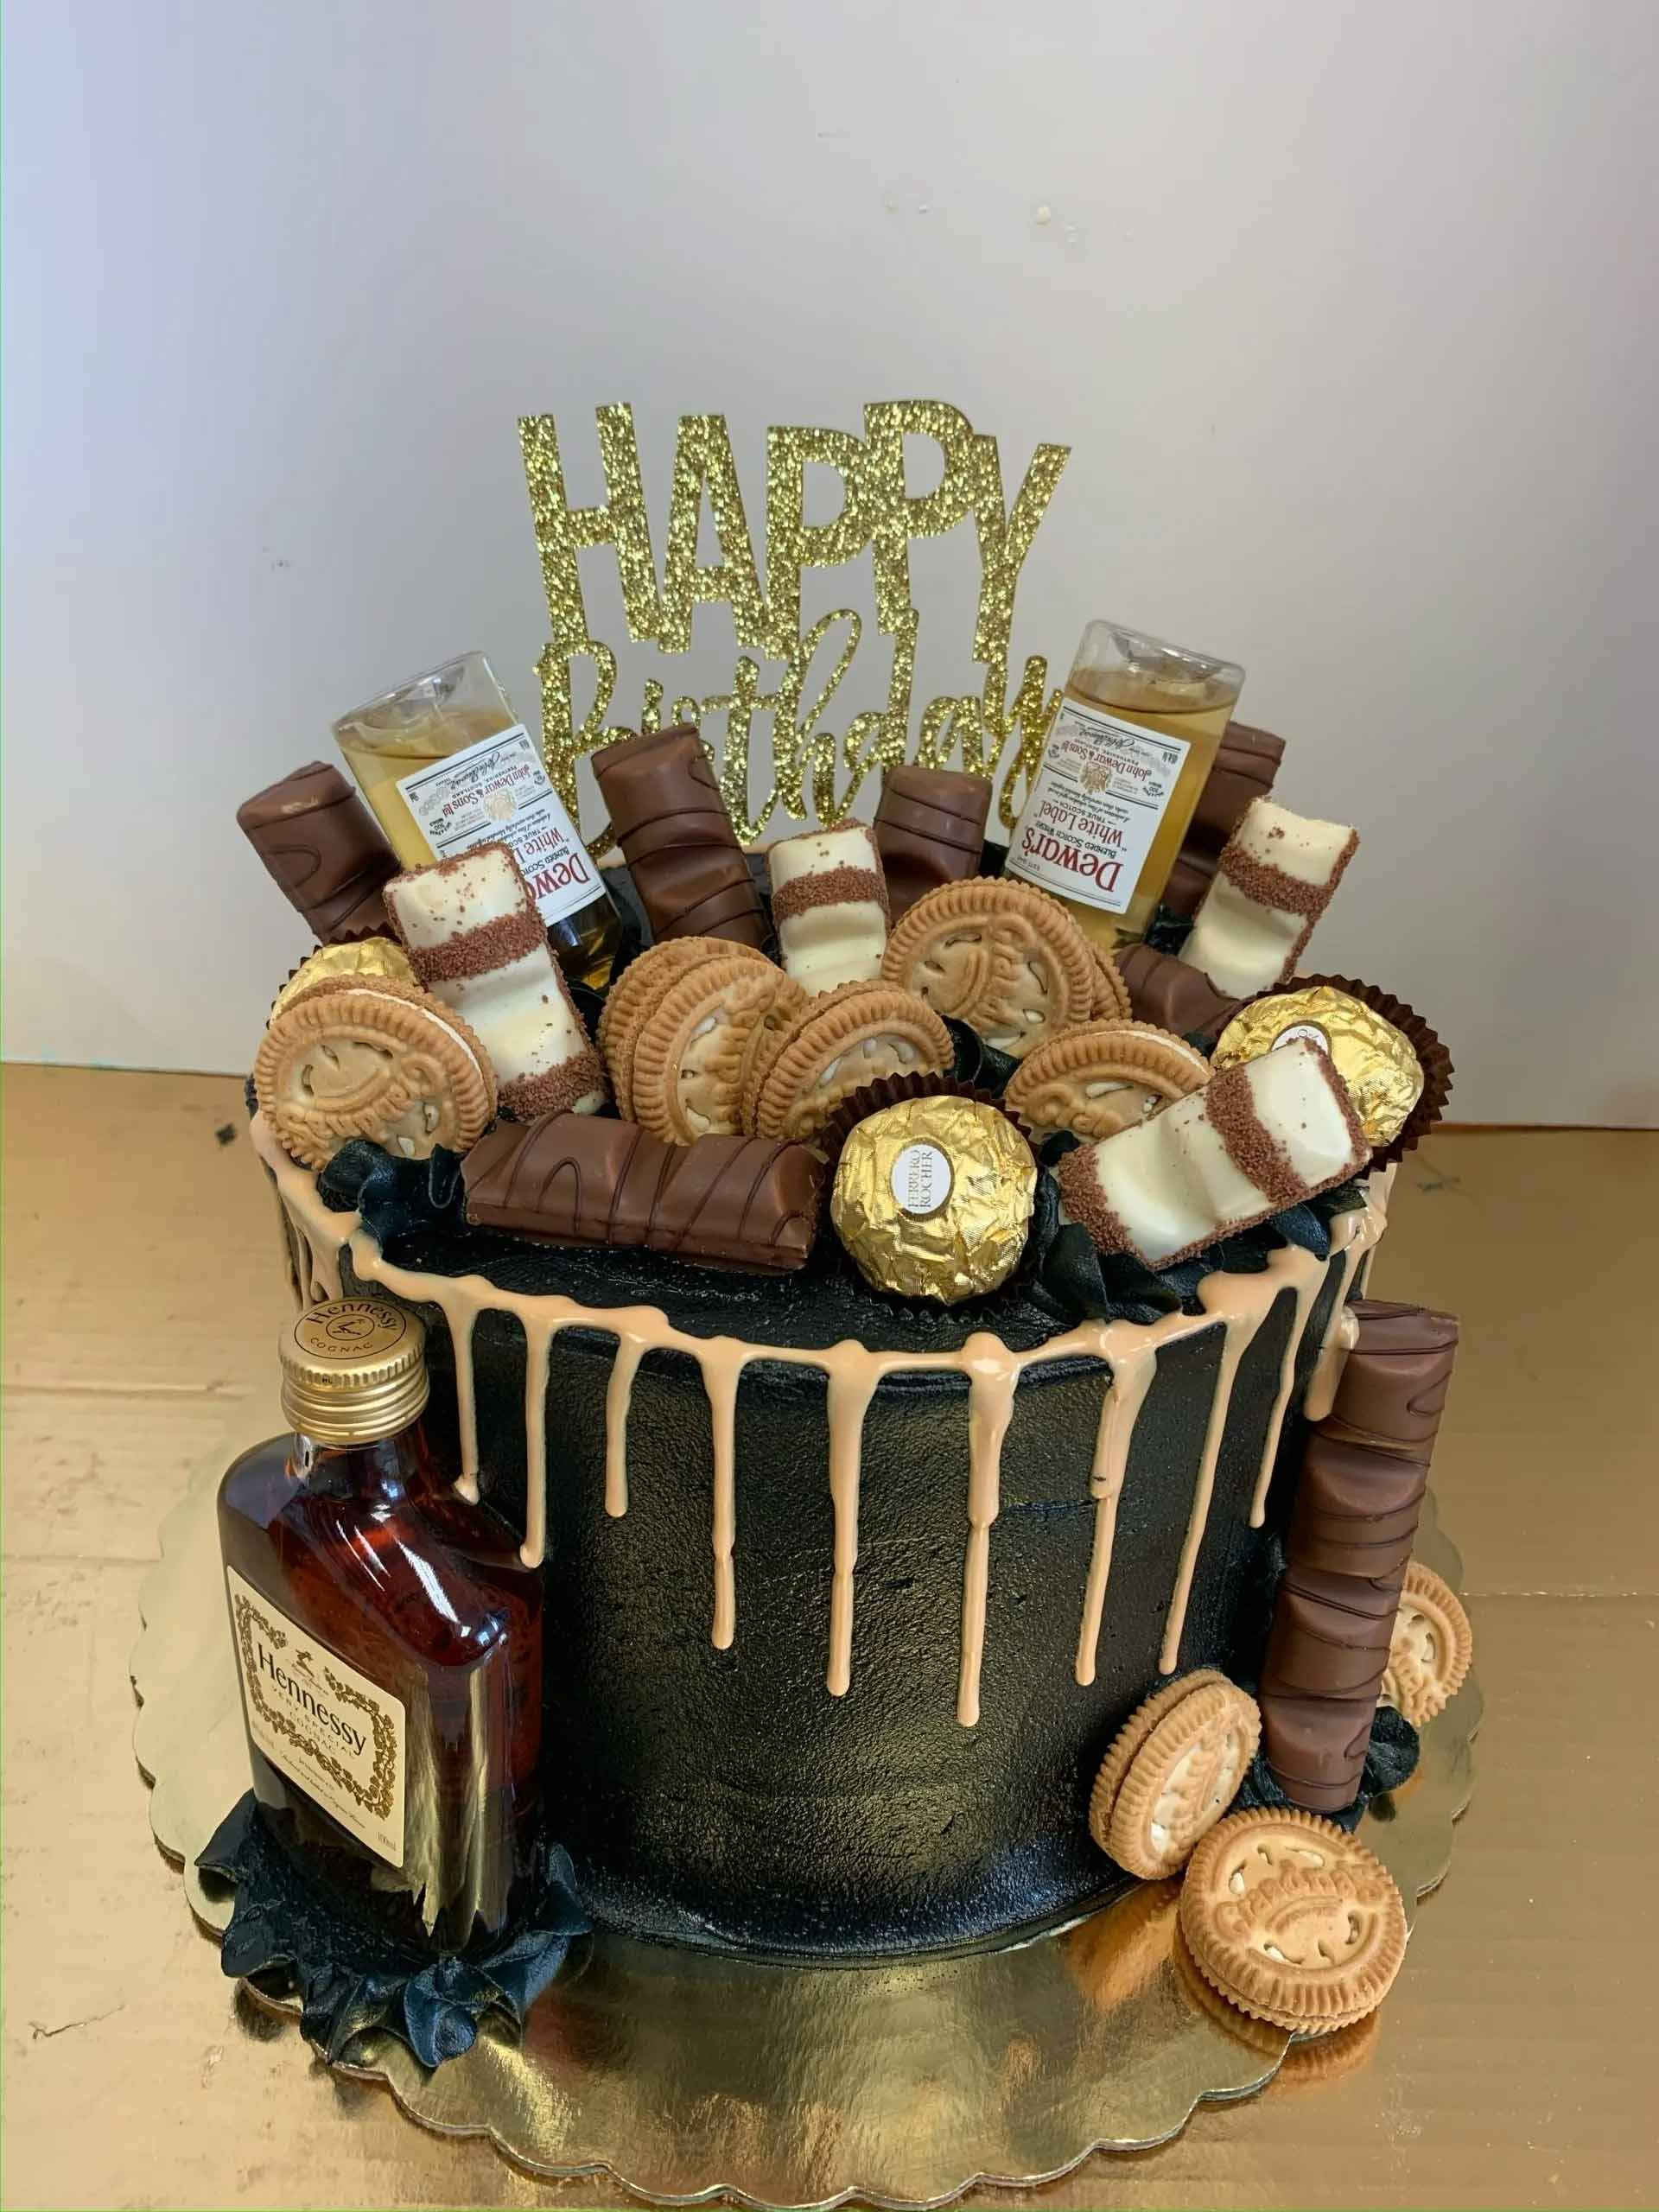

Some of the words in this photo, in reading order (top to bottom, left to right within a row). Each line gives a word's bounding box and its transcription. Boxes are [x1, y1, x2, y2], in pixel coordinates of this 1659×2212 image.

[518, 399, 1071, 663] HAPPY
[1068, 744, 1087, 761] Sons
[1087, 752, 1094, 762] &
[1094, 754, 1126, 774] Dewar
[1125, 764, 1152, 781] John
[484, 773, 513, 795] Dewar
[512, 765, 531, 784] John
[453, 790, 478, 809] Sons
[476, 787, 483, 798] &
[1087, 810, 1106, 823] TRUE
[1021, 827, 1123, 892] Dewar's
[919, 1151, 934, 1207] ROCHER
[306, 1301, 398, 1331] Hennessy
[310, 1337, 373, 1352] COGNAC
[258, 1642, 366, 1756] Hennessy
